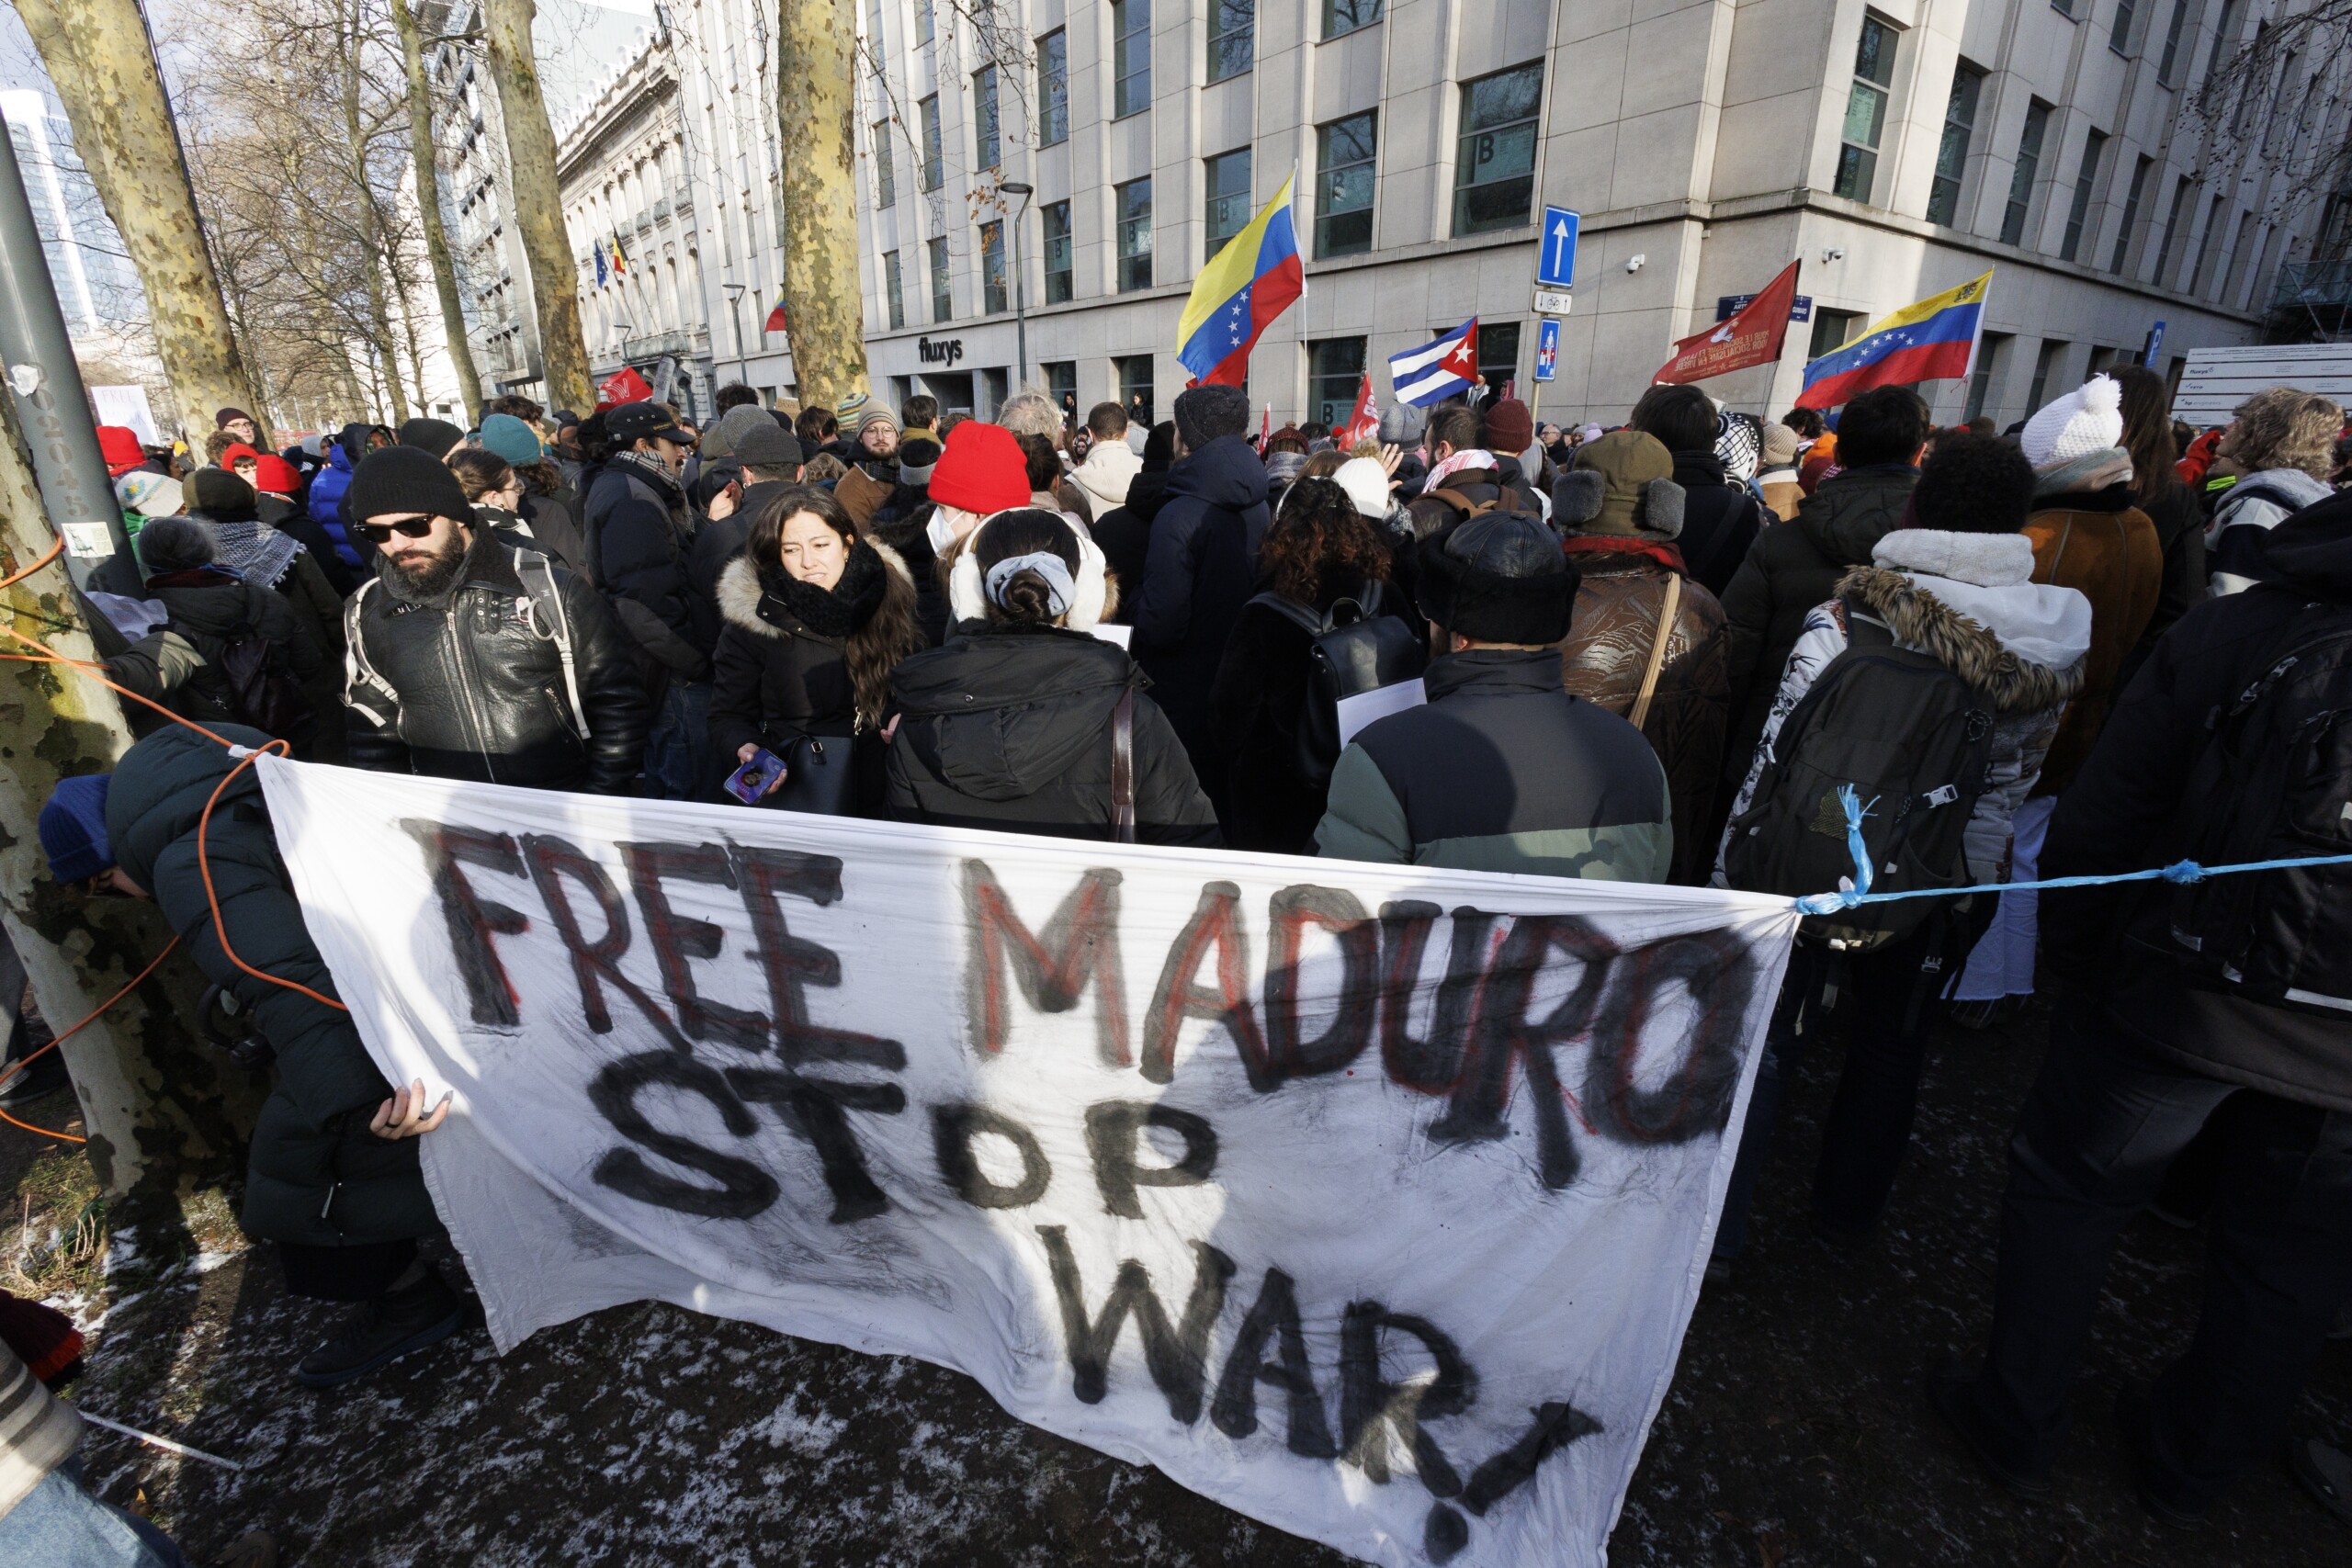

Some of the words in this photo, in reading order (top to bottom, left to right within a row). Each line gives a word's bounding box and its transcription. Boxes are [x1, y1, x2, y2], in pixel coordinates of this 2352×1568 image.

[1477, 134, 1494, 164] B
[919, 336, 962, 367] fluxys
[1323, 403, 1334, 425] B
[400, 818, 908, 1072] FREE
[961, 857, 1762, 1188] MADURO
[587, 1049, 1220, 1224] STOP
[1035, 1224, 1603, 1567] WAR!
